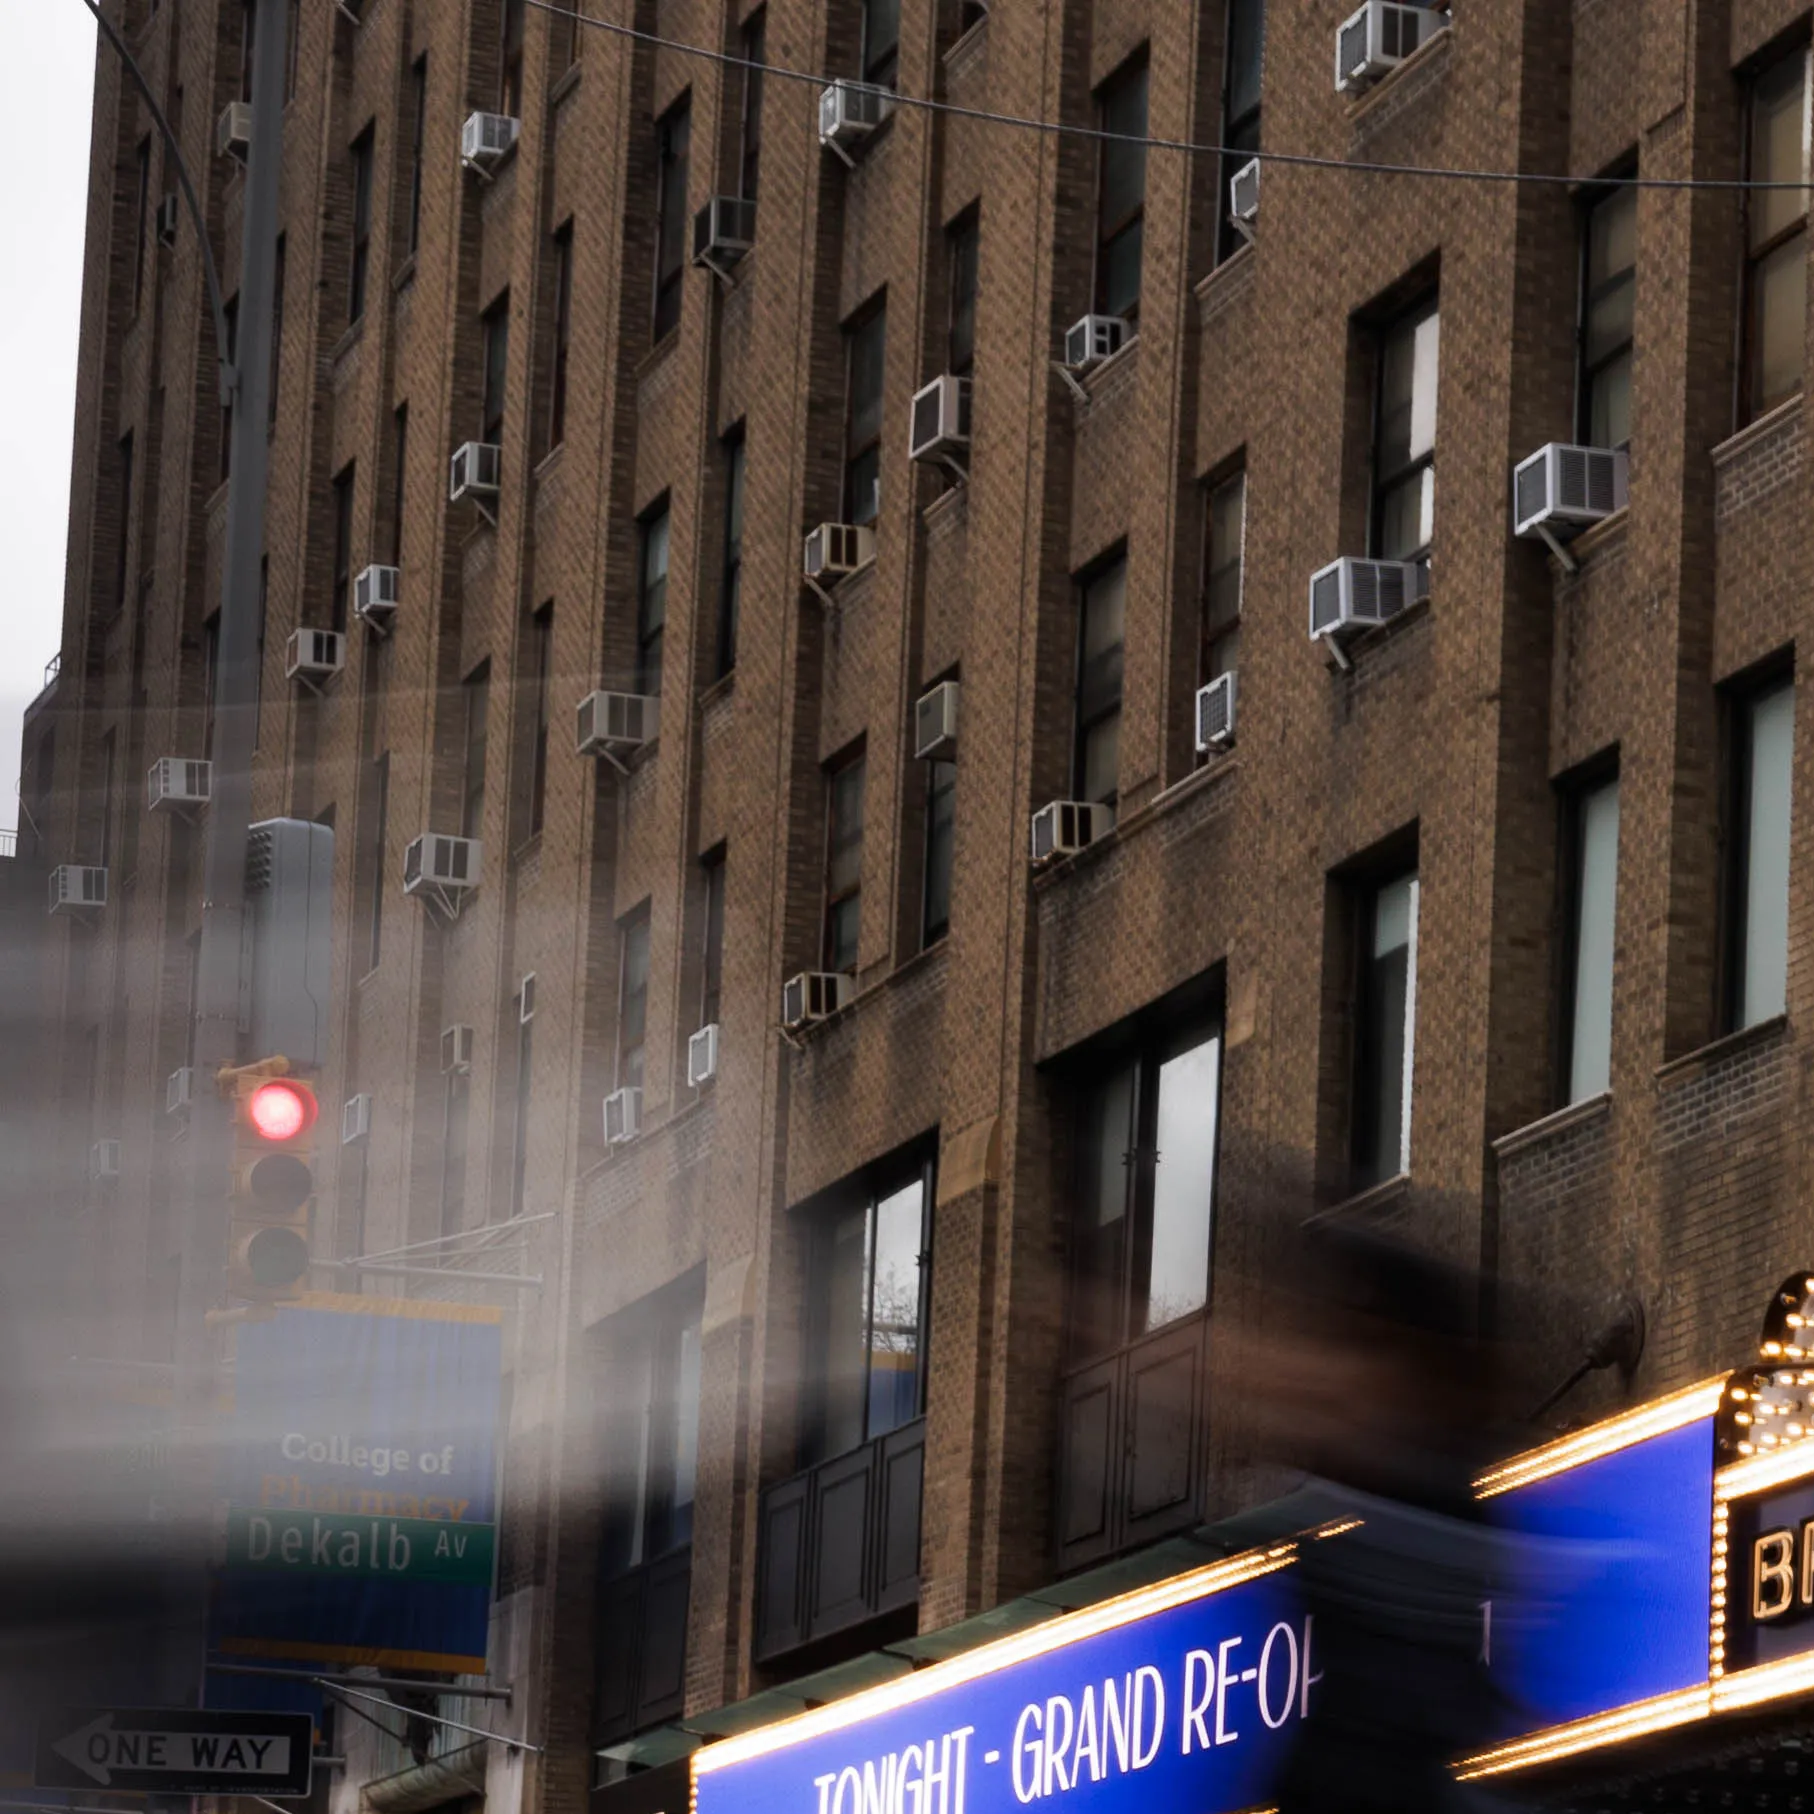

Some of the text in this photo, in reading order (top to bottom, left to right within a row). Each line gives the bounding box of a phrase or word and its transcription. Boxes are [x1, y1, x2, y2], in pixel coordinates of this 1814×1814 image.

[281, 1432, 455, 1476] College of
[260, 1474, 469, 1522] Pharmacy
[248, 1516, 467, 1572] Dekalb Av
[88, 1733, 273, 1769] ONE WAY
[1011, 1663, 1166, 1804] GRAND
